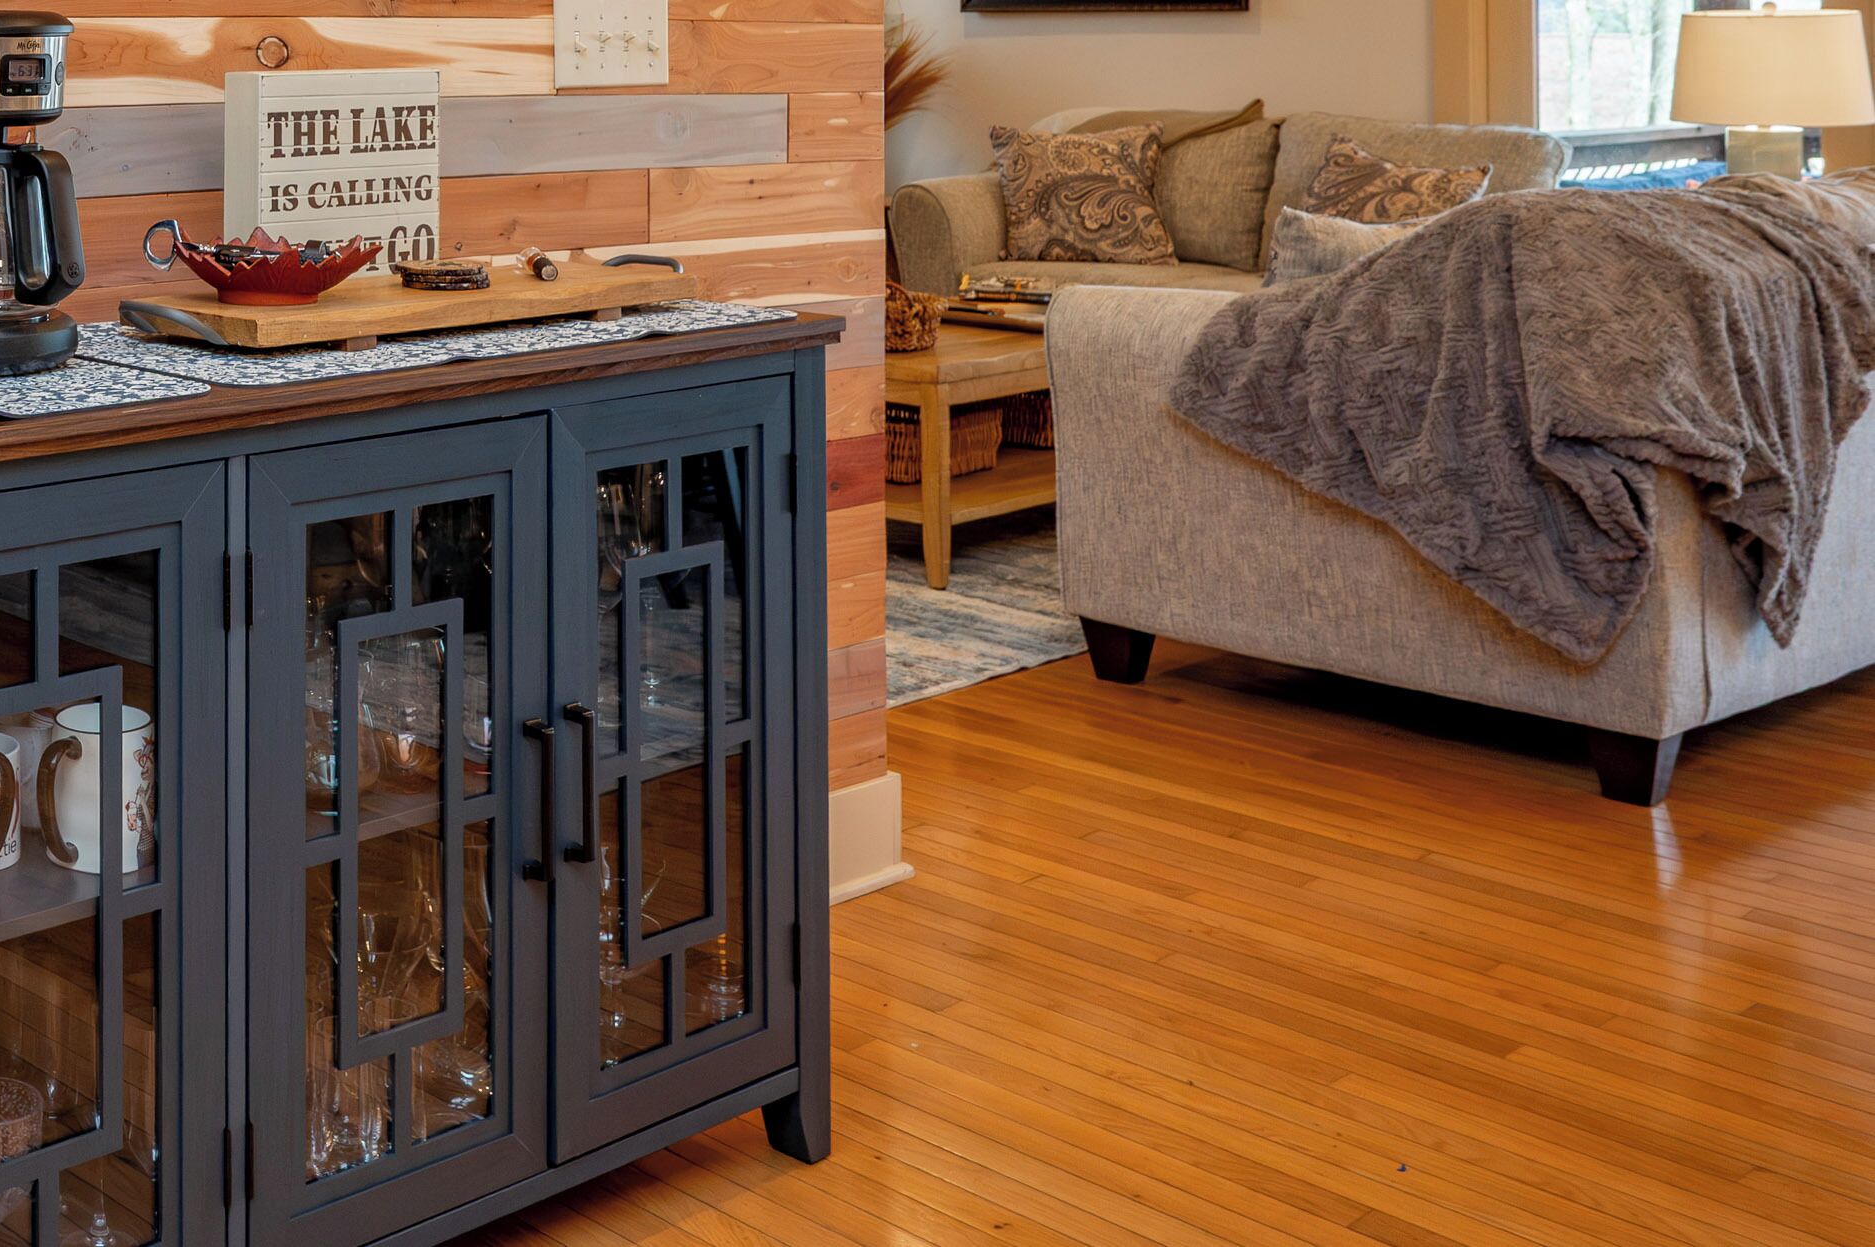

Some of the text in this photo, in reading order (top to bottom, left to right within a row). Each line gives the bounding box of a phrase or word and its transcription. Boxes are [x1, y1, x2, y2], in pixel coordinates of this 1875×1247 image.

[267, 105, 436, 158] THE LAKE
[269, 175, 432, 213] IS CALLING
[388, 223, 435, 274] GO
